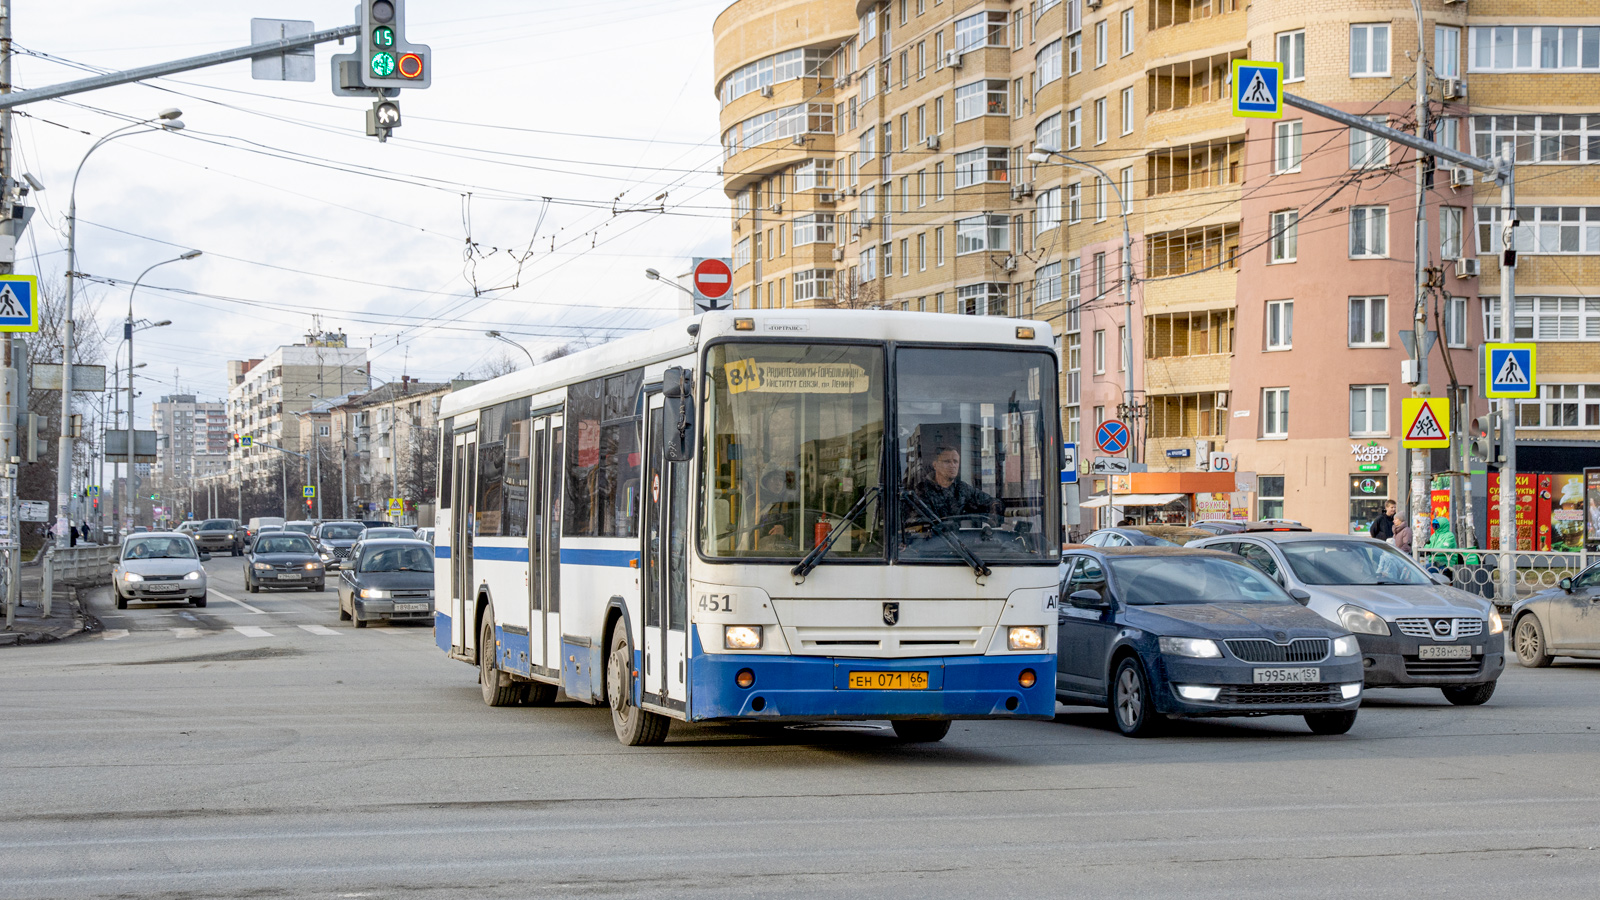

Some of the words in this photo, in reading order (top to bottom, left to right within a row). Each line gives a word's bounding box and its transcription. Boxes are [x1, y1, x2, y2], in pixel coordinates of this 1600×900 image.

[376, 30, 393, 46] 15
[729, 364, 756, 386] 84
[1199, 501, 1228, 509] ФРУКТЫ
[699, 594, 732, 612] 451
[878, 674, 902, 687] 071
[910, 673, 923, 683] 66
[1302, 669, 1317, 678] 159
